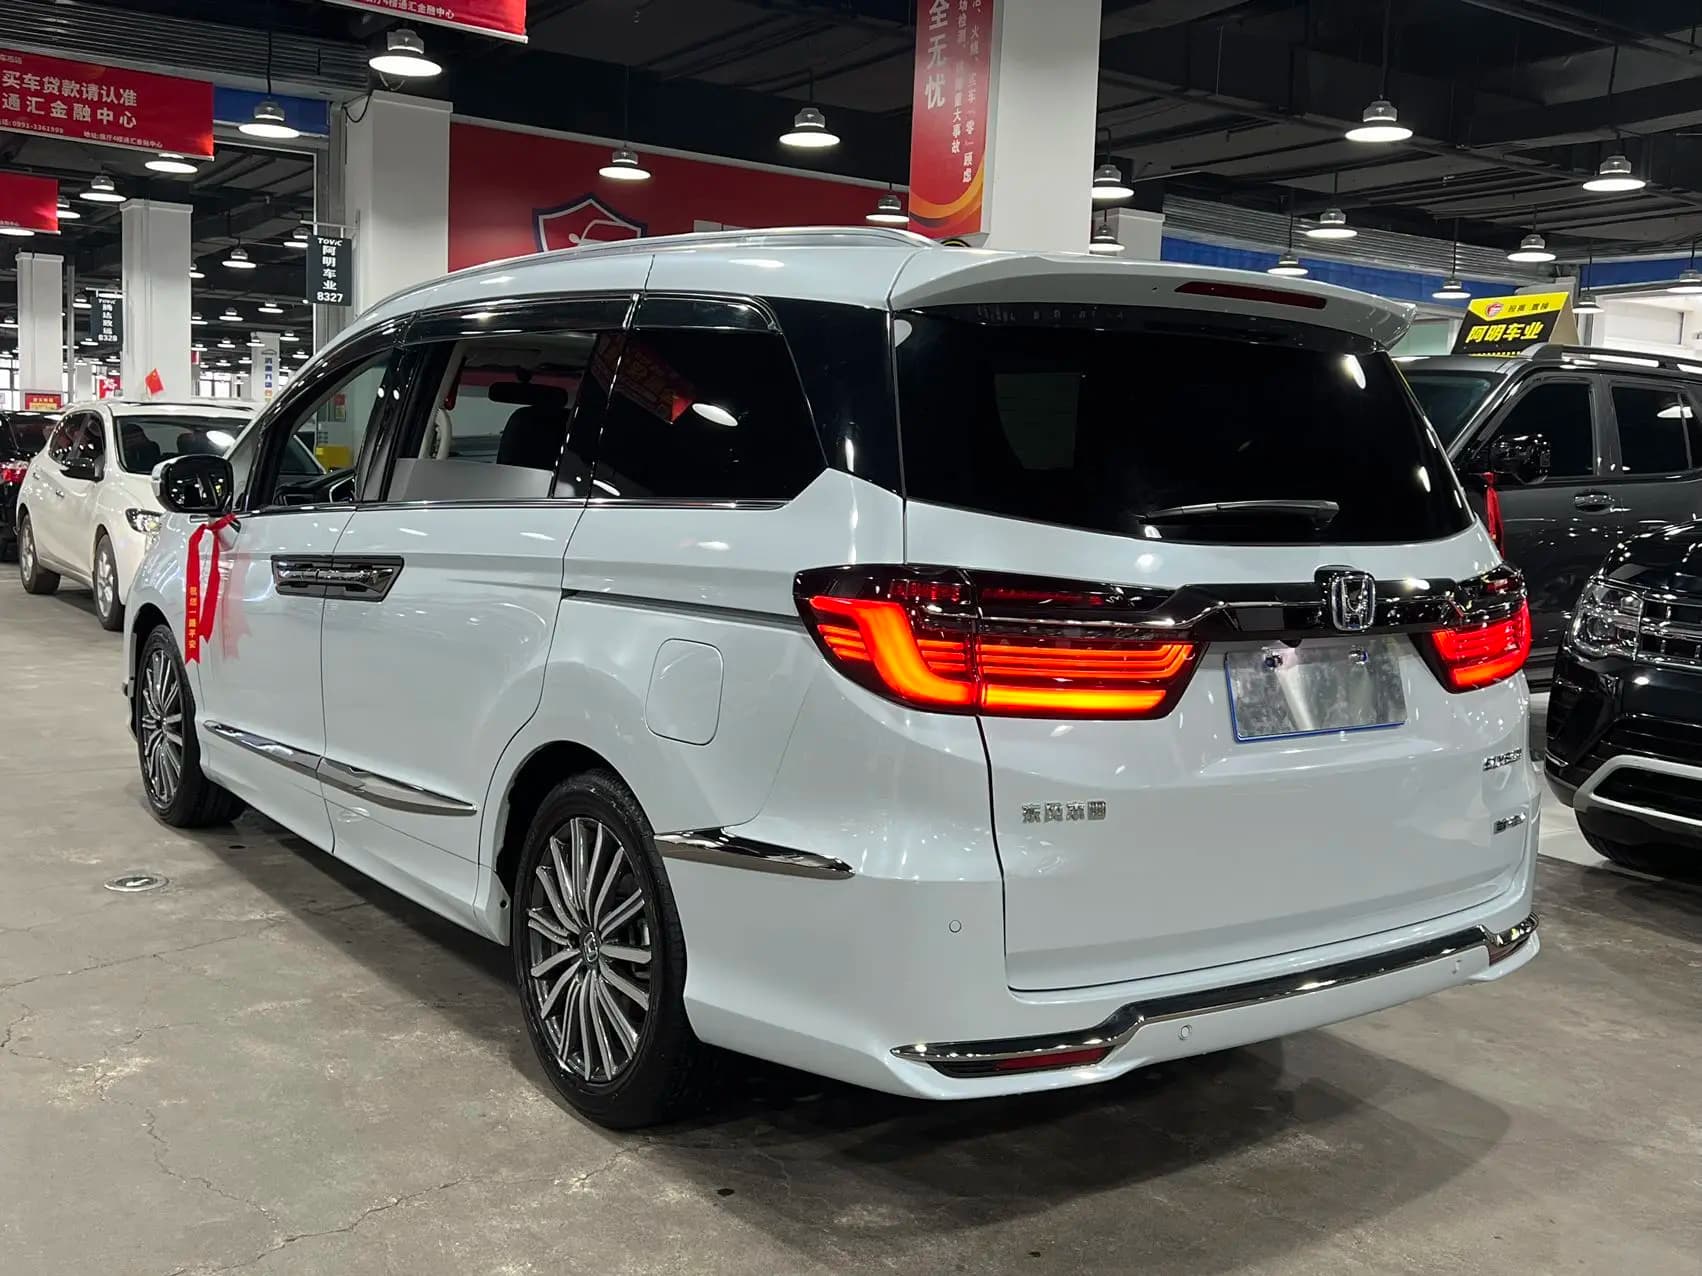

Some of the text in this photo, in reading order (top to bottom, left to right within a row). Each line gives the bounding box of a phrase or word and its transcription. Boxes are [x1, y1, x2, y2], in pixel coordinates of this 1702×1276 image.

[2, 70, 138, 107] 买车贷款请认准
[2, 93, 137, 128] 通汇金融中心
[322, 245, 337, 290] 阿明车业
[317, 291, 343, 303] 8327
[1465, 321, 1544, 343] 阿明车业
